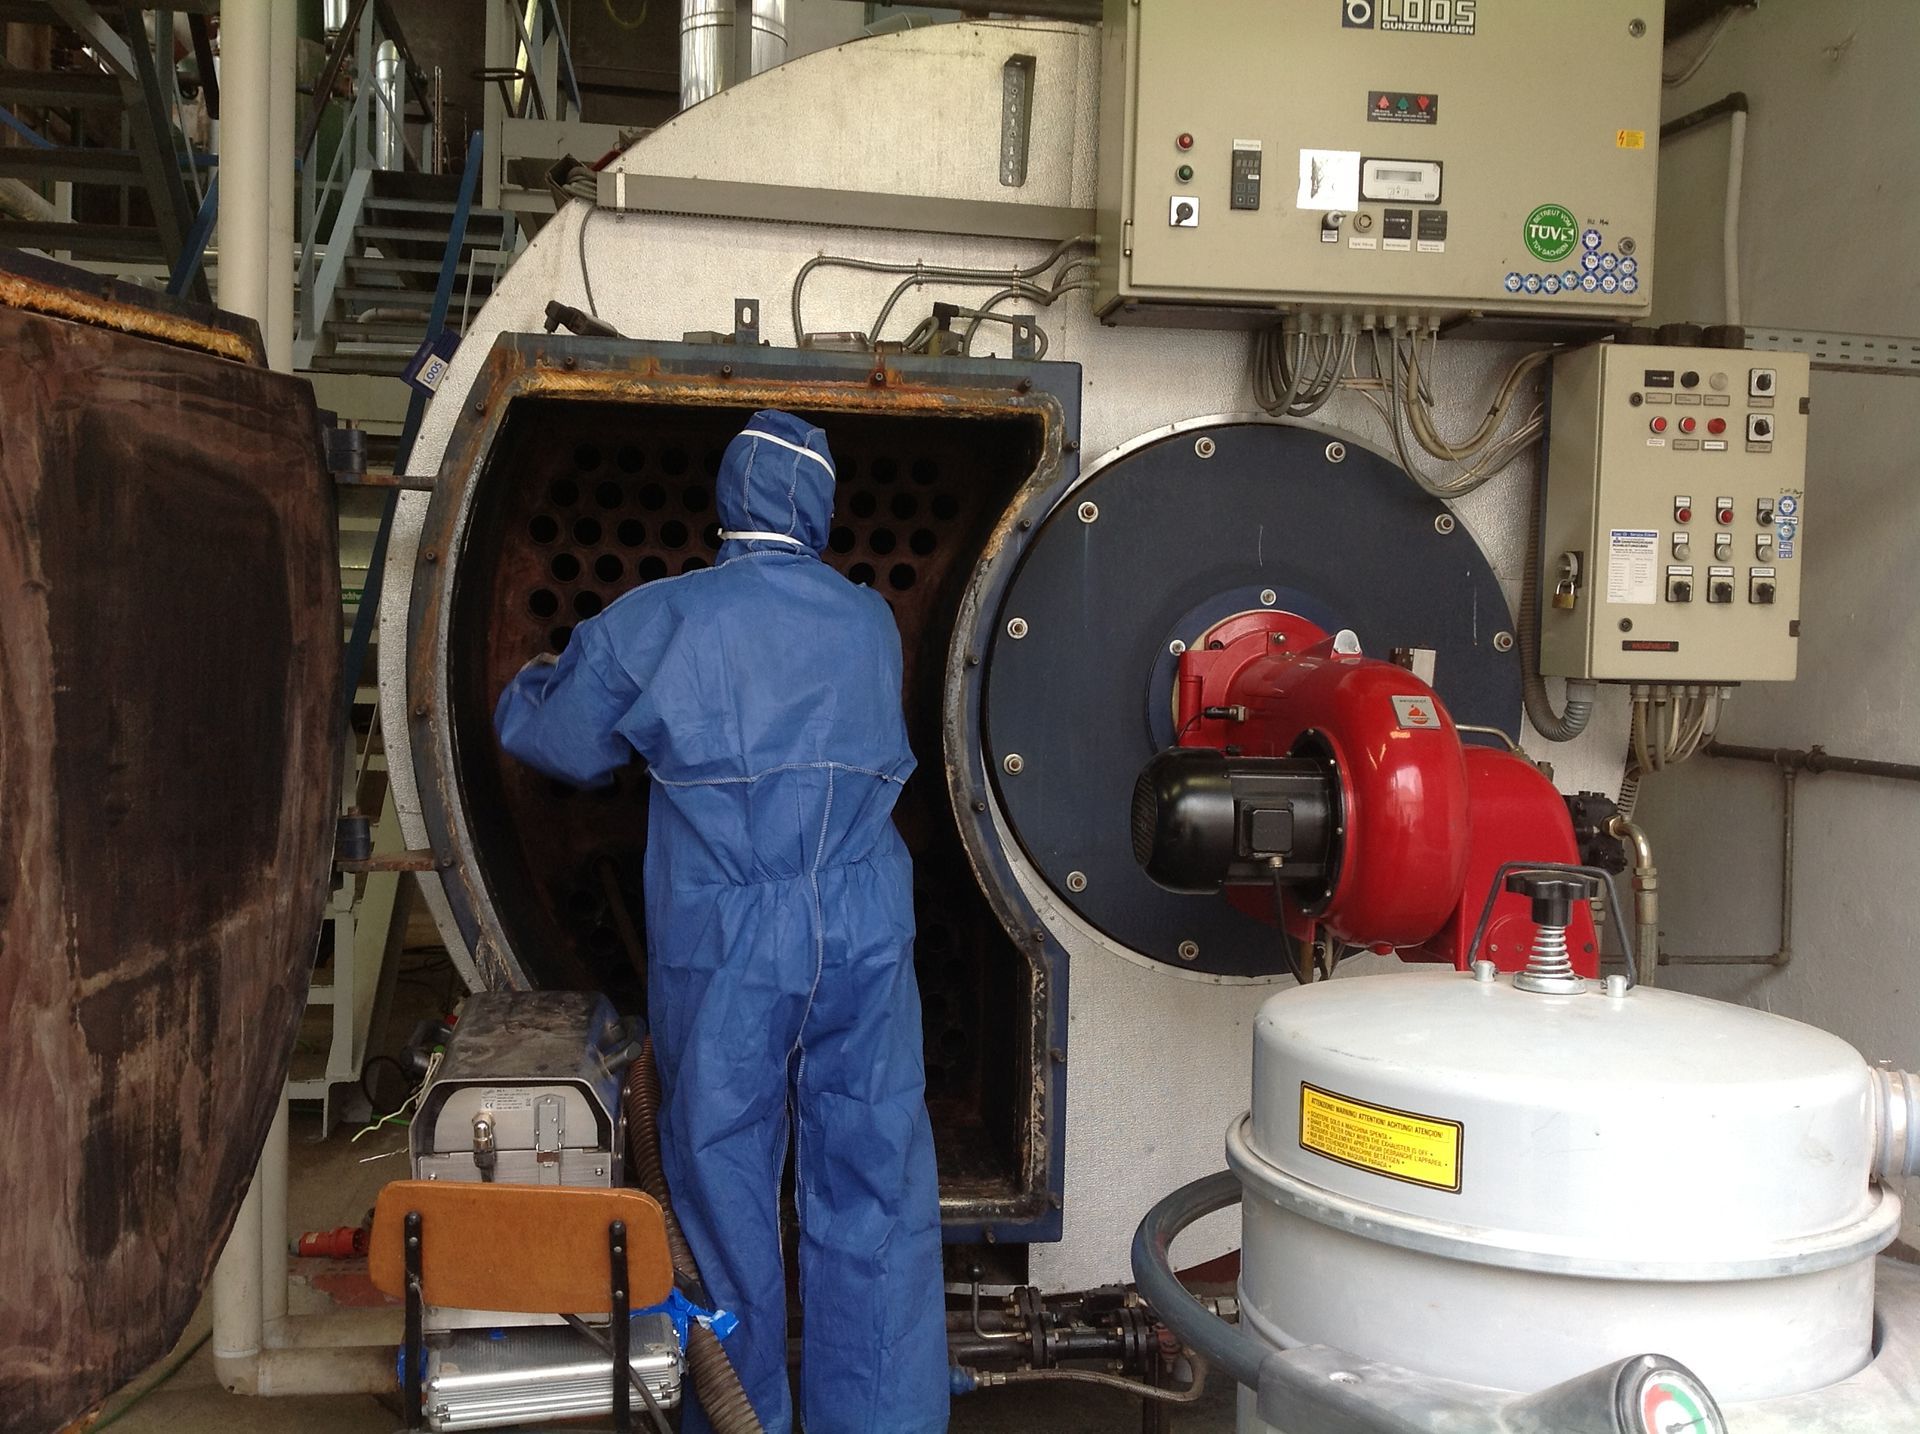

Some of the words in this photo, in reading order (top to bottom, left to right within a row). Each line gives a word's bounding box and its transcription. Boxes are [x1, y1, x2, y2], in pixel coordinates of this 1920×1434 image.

[1382, 0, 1475, 25] LOOS
[1382, 21, 1474, 34] GUNZENHAUSEN
[1529, 224, 1561, 240] TÜV
[423, 361, 442, 384] LOOS
[1359, 1113, 1386, 1125] ATTENTION!
[1387, 1121, 1413, 1133] ACHTUNG!
